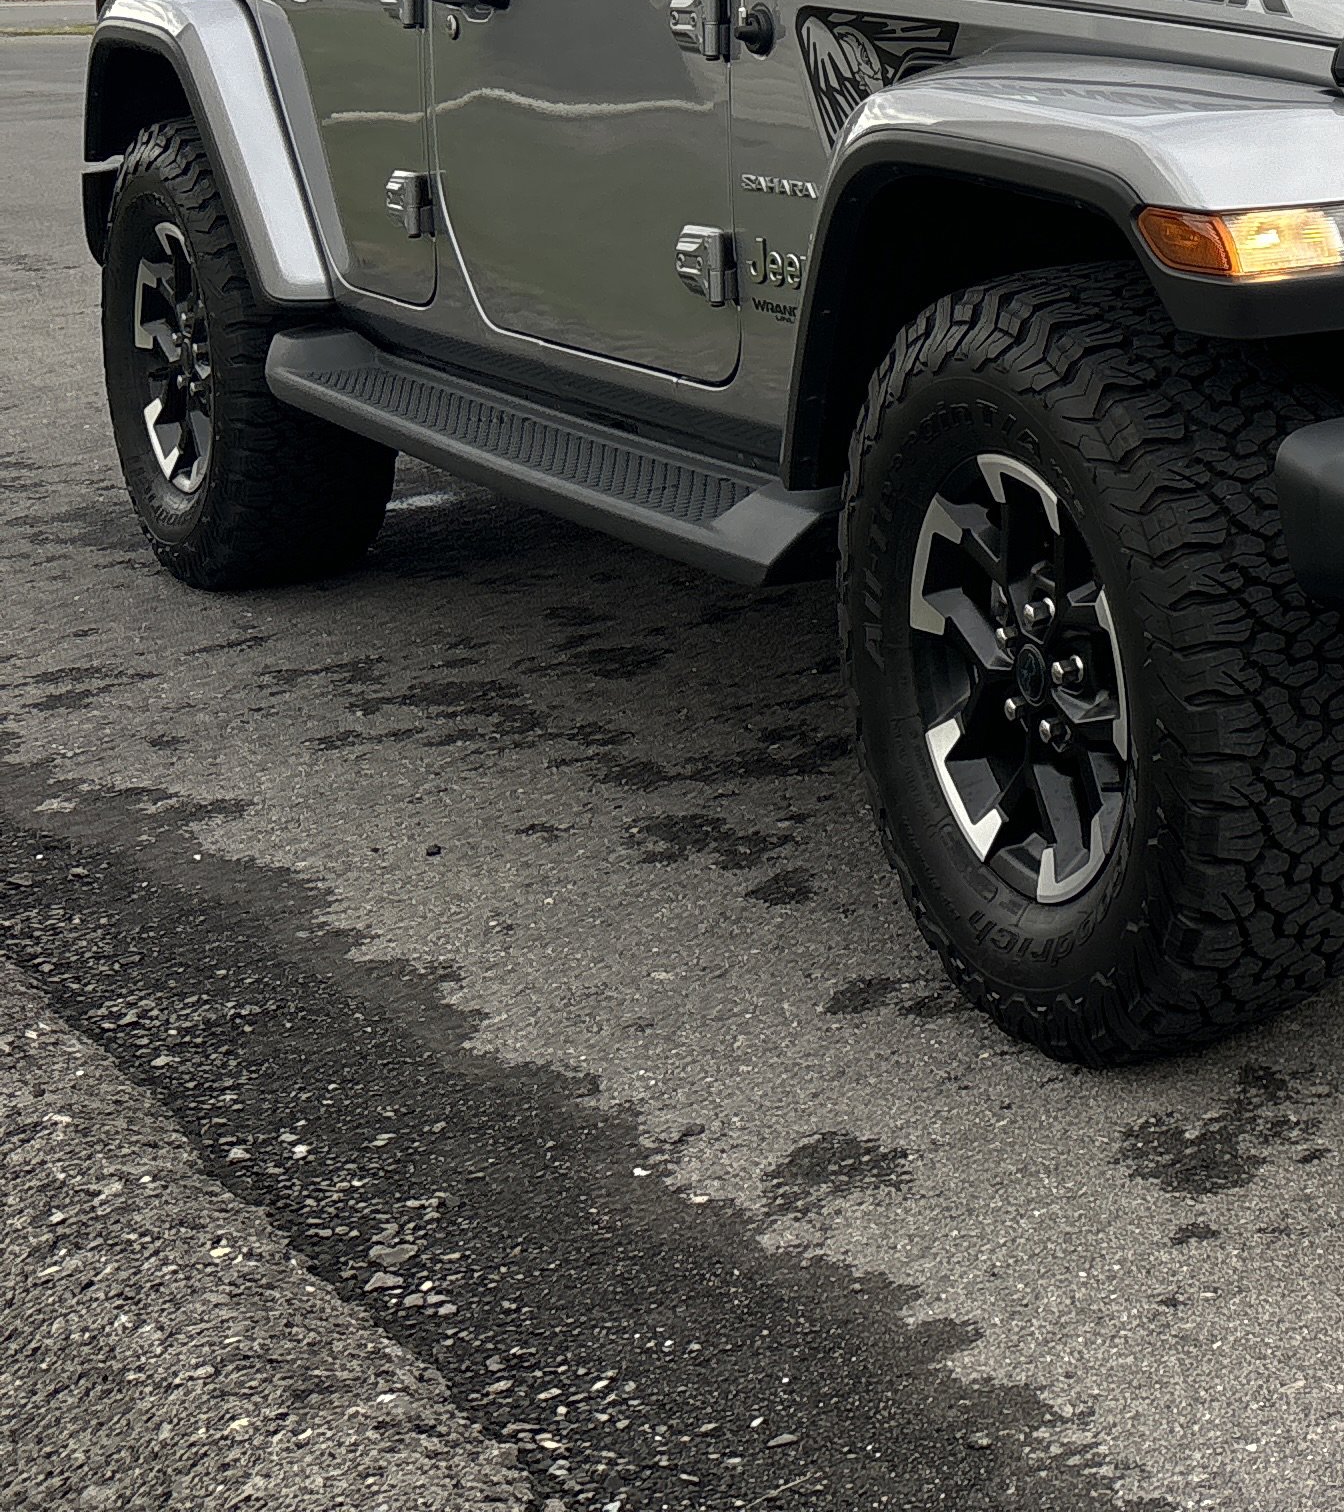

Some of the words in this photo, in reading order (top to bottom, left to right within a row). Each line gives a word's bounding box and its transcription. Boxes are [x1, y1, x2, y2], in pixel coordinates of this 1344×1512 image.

[740, 173, 818, 199] SAHARA
[745, 237, 807, 289] Jee
[752, 296, 798, 317] WRAN
